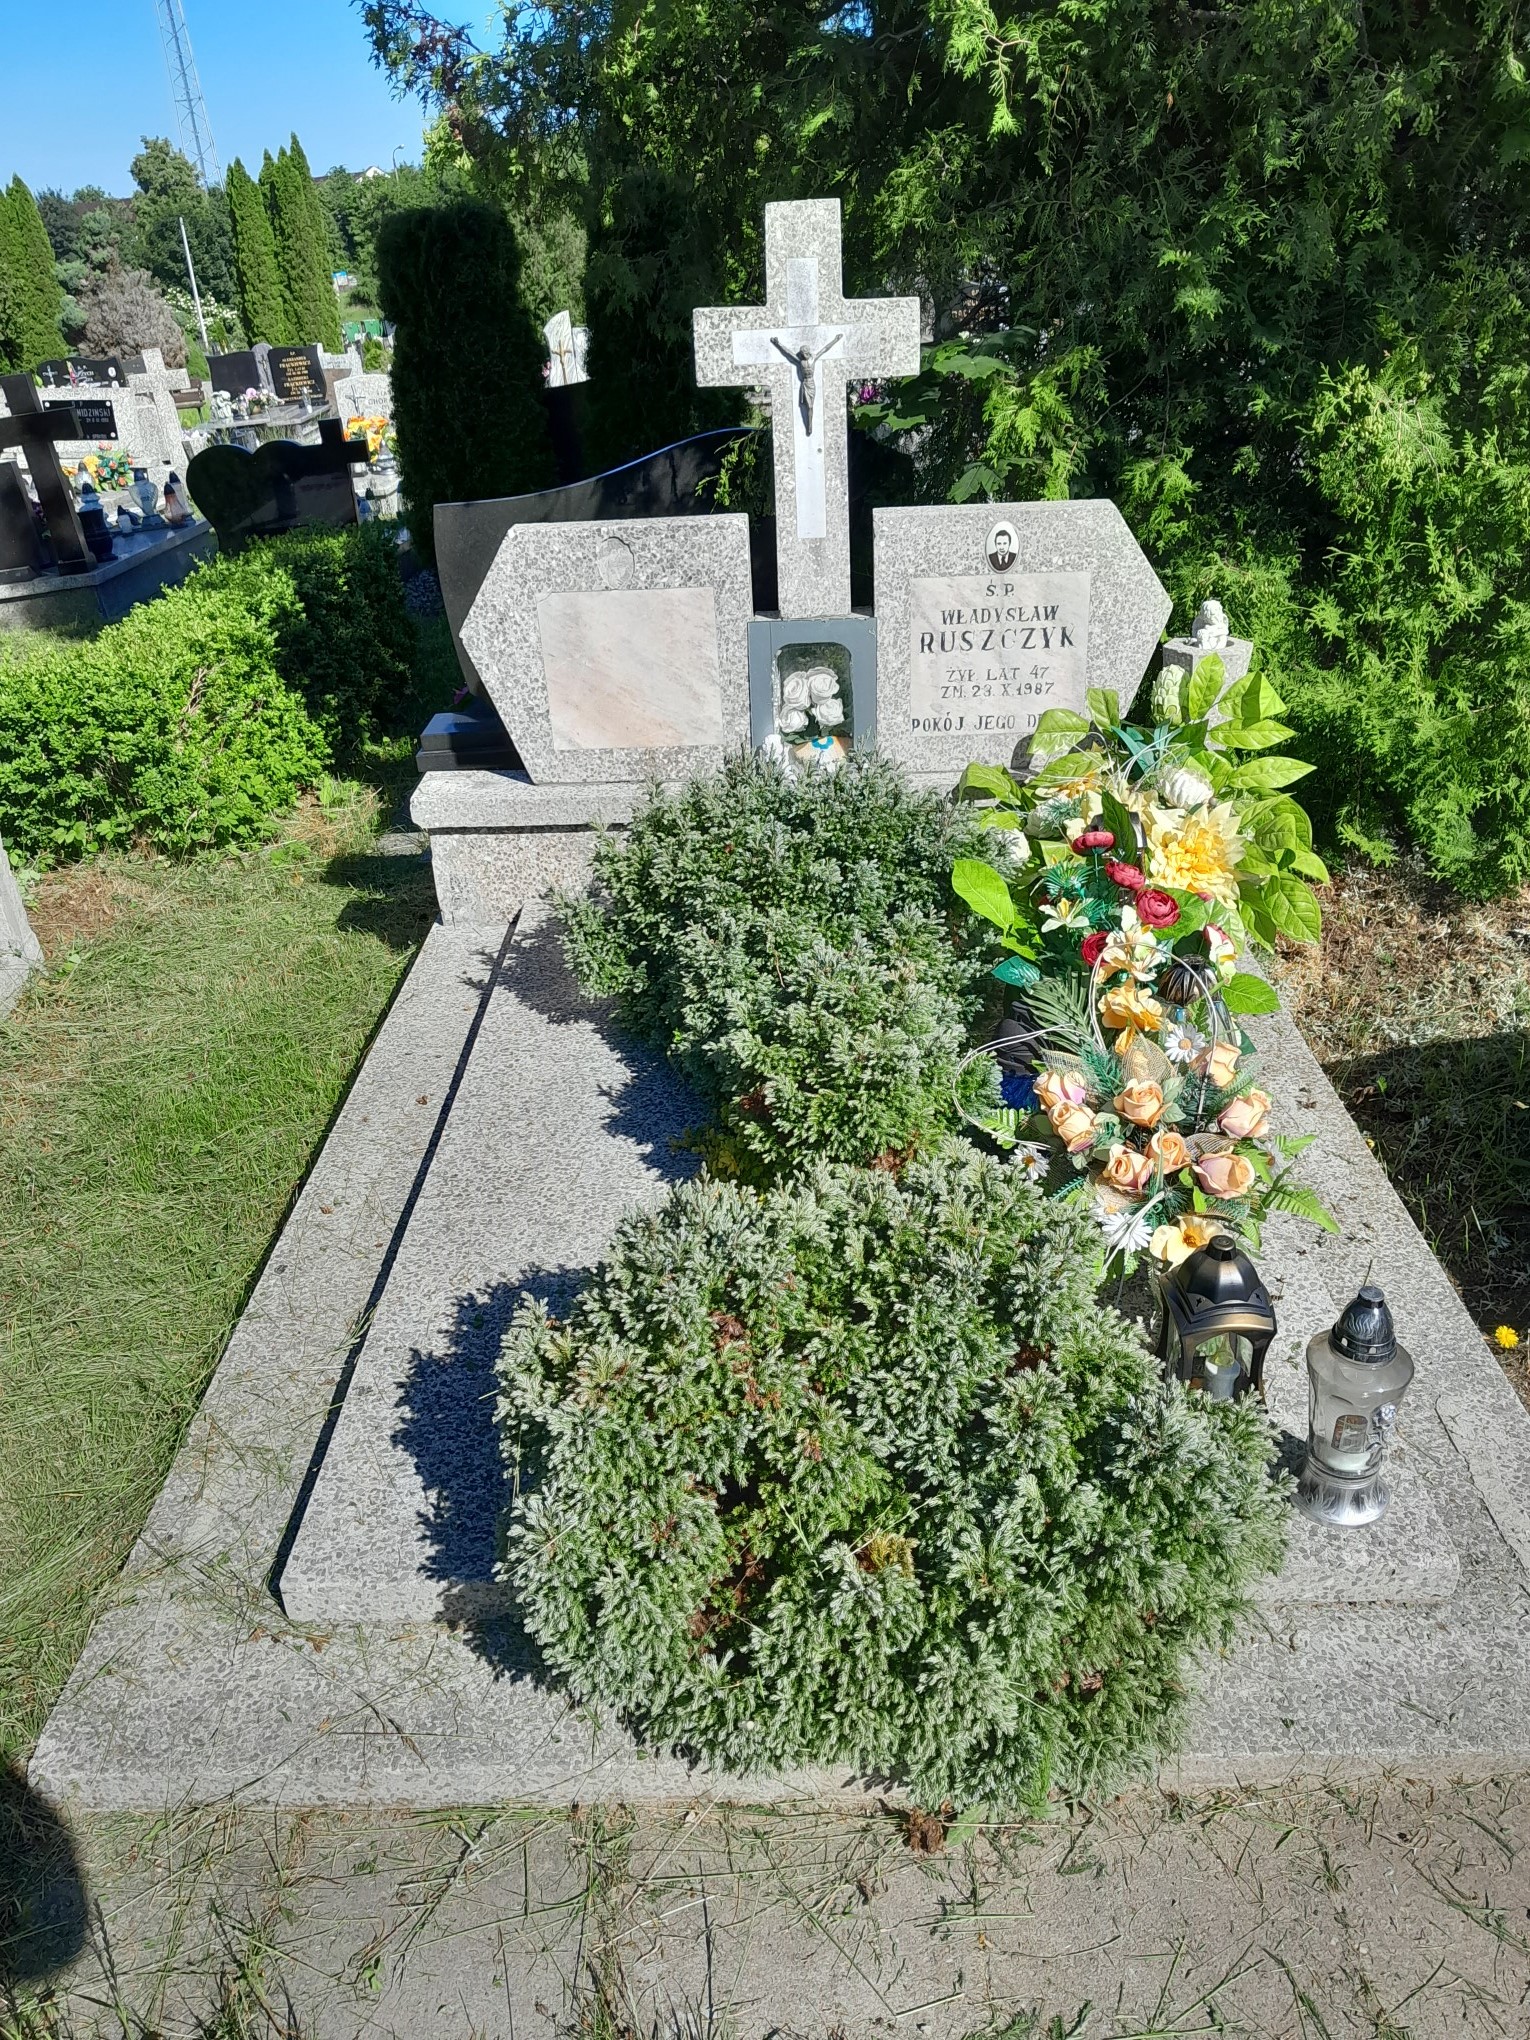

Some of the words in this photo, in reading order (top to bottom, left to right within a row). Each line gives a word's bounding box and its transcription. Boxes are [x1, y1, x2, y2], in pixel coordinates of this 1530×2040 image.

[941, 605, 1060, 626] WŁADYSŁAW
[920, 624, 1075, 653] RUSZCZYK
[986, 667, 1020, 680] LAT
[1029, 665, 1049, 679] 47
[912, 712, 965, 732] POKÓJ
[974, 715, 1016, 730] JEGO
